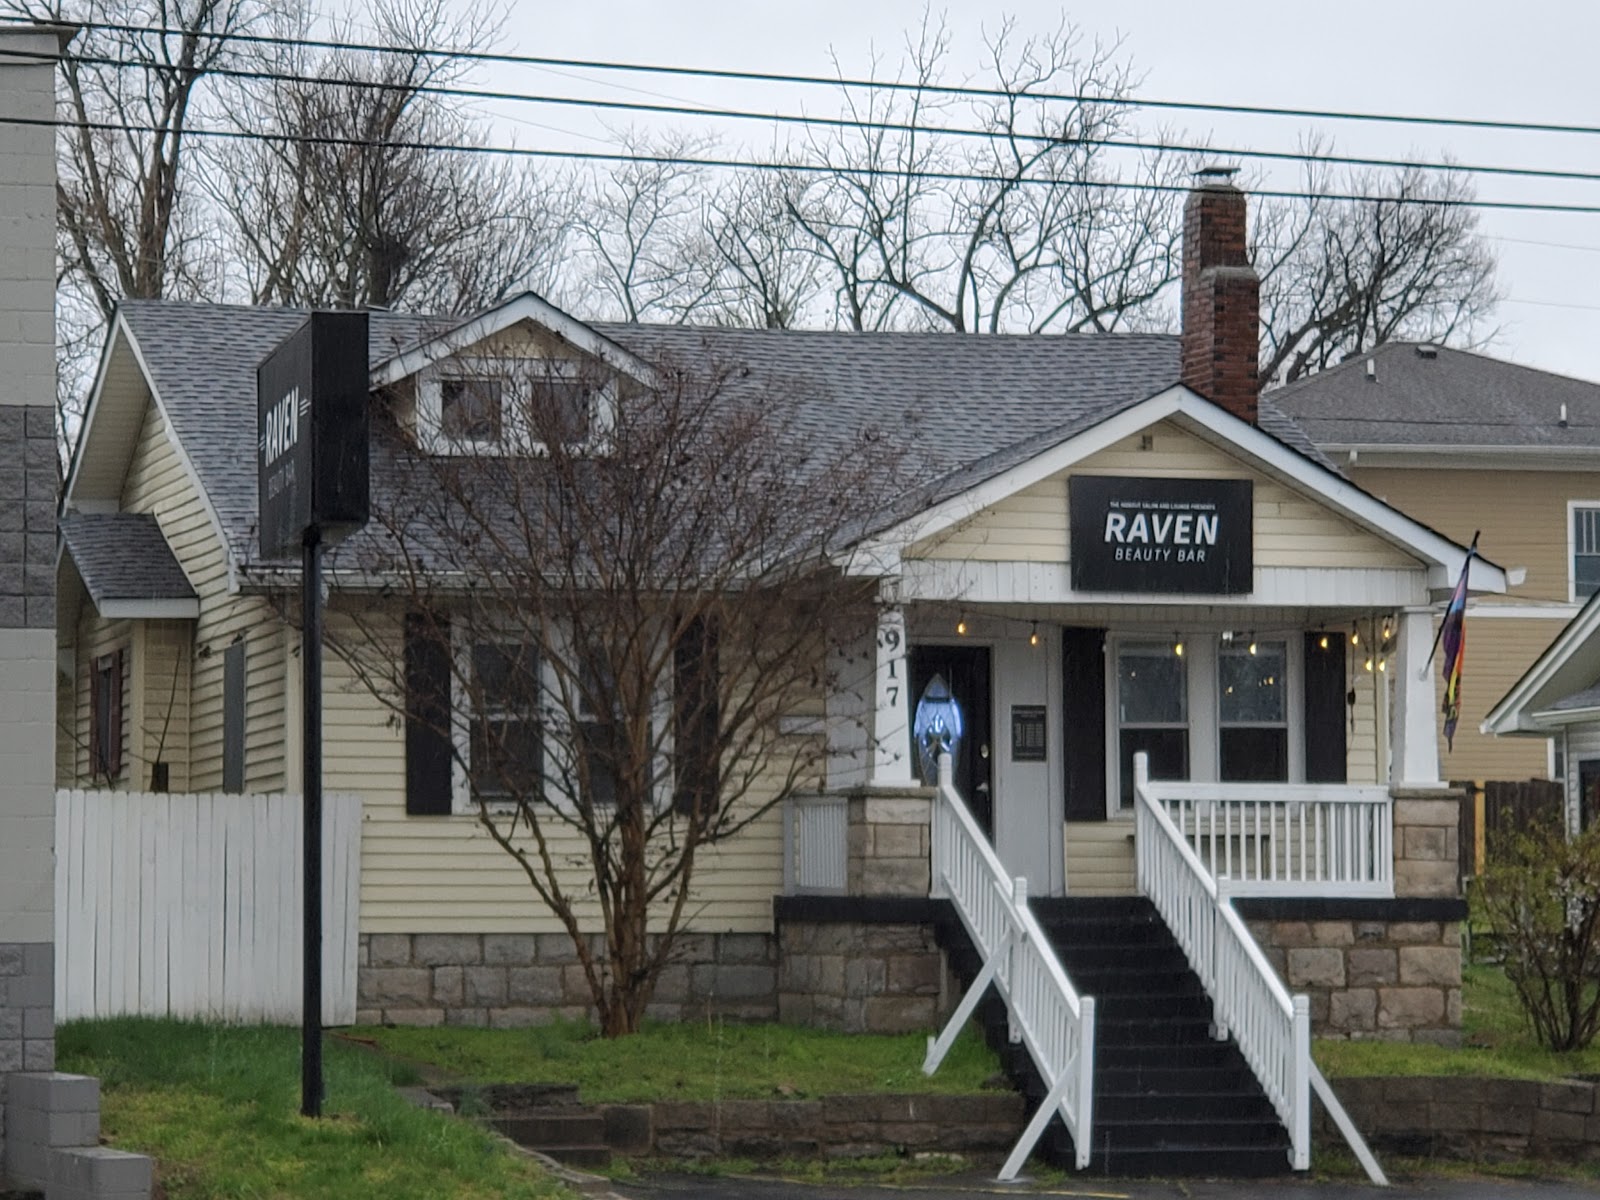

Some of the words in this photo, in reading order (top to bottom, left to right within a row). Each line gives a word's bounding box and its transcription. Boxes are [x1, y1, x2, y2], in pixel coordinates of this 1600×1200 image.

[264, 385, 299, 467] RAVEN
[1104, 513, 1219, 546] RAVEN
[1115, 547, 1171, 561] BEAUTY
[1177, 549, 1206, 562] BAR
